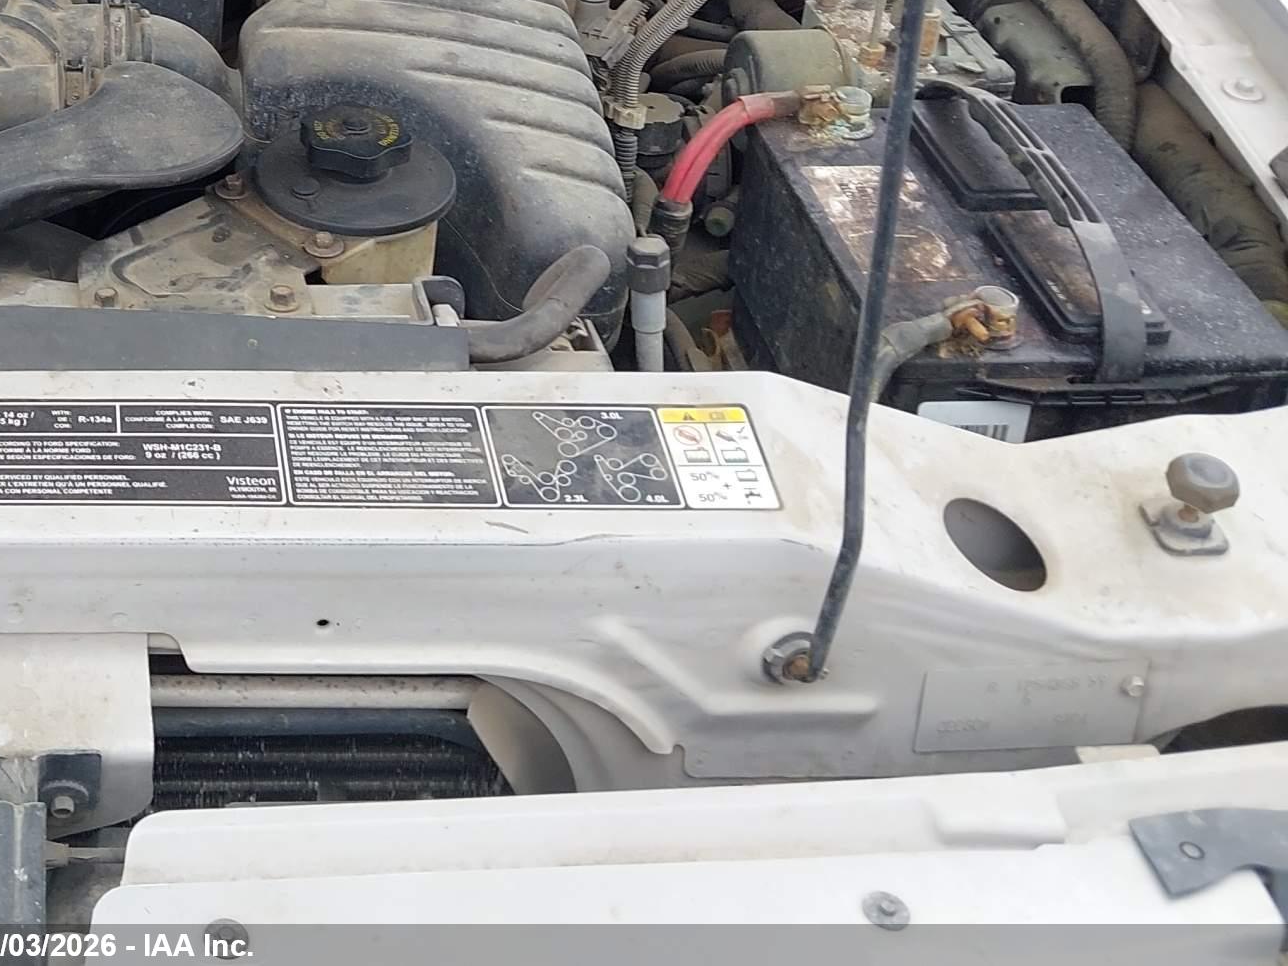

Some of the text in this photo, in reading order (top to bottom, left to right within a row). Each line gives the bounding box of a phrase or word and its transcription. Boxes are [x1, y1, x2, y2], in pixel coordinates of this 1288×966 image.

[220, 416, 268, 424] SAE J639
[142, 443, 222, 451] WSH-M1C231-B
[226, 476, 276, 486] Visteon
[690, 471, 720, 482] 50%
[699, 492, 728, 502] 50%
